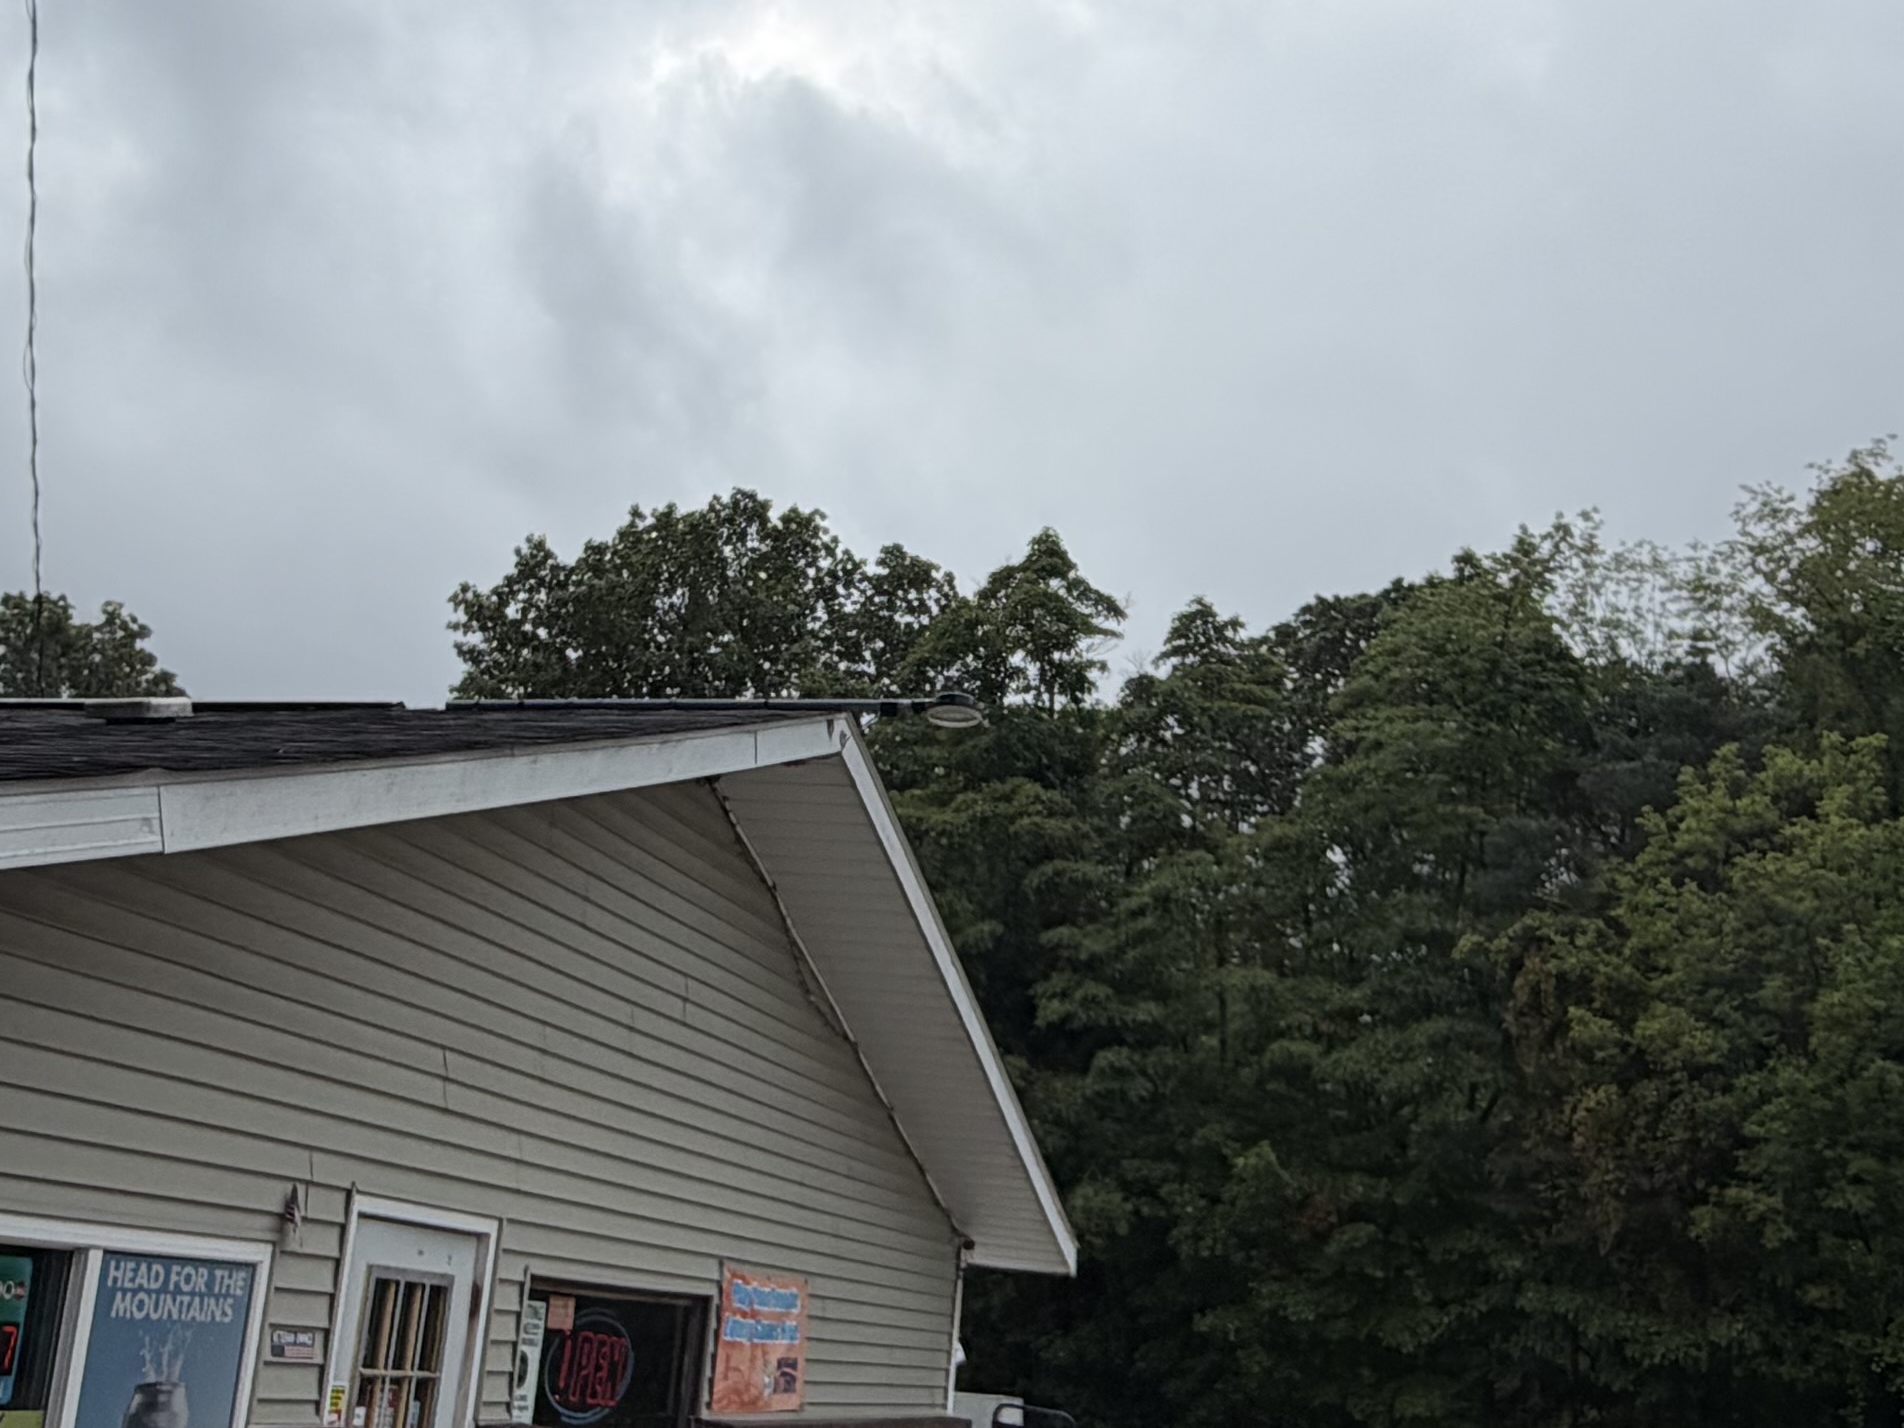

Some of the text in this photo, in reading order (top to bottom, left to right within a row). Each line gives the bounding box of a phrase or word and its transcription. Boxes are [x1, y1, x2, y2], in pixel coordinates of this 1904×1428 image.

[107, 1259, 246, 1296] HEAD FOR THE
[109, 1290, 235, 1323] MOUNTAINS
